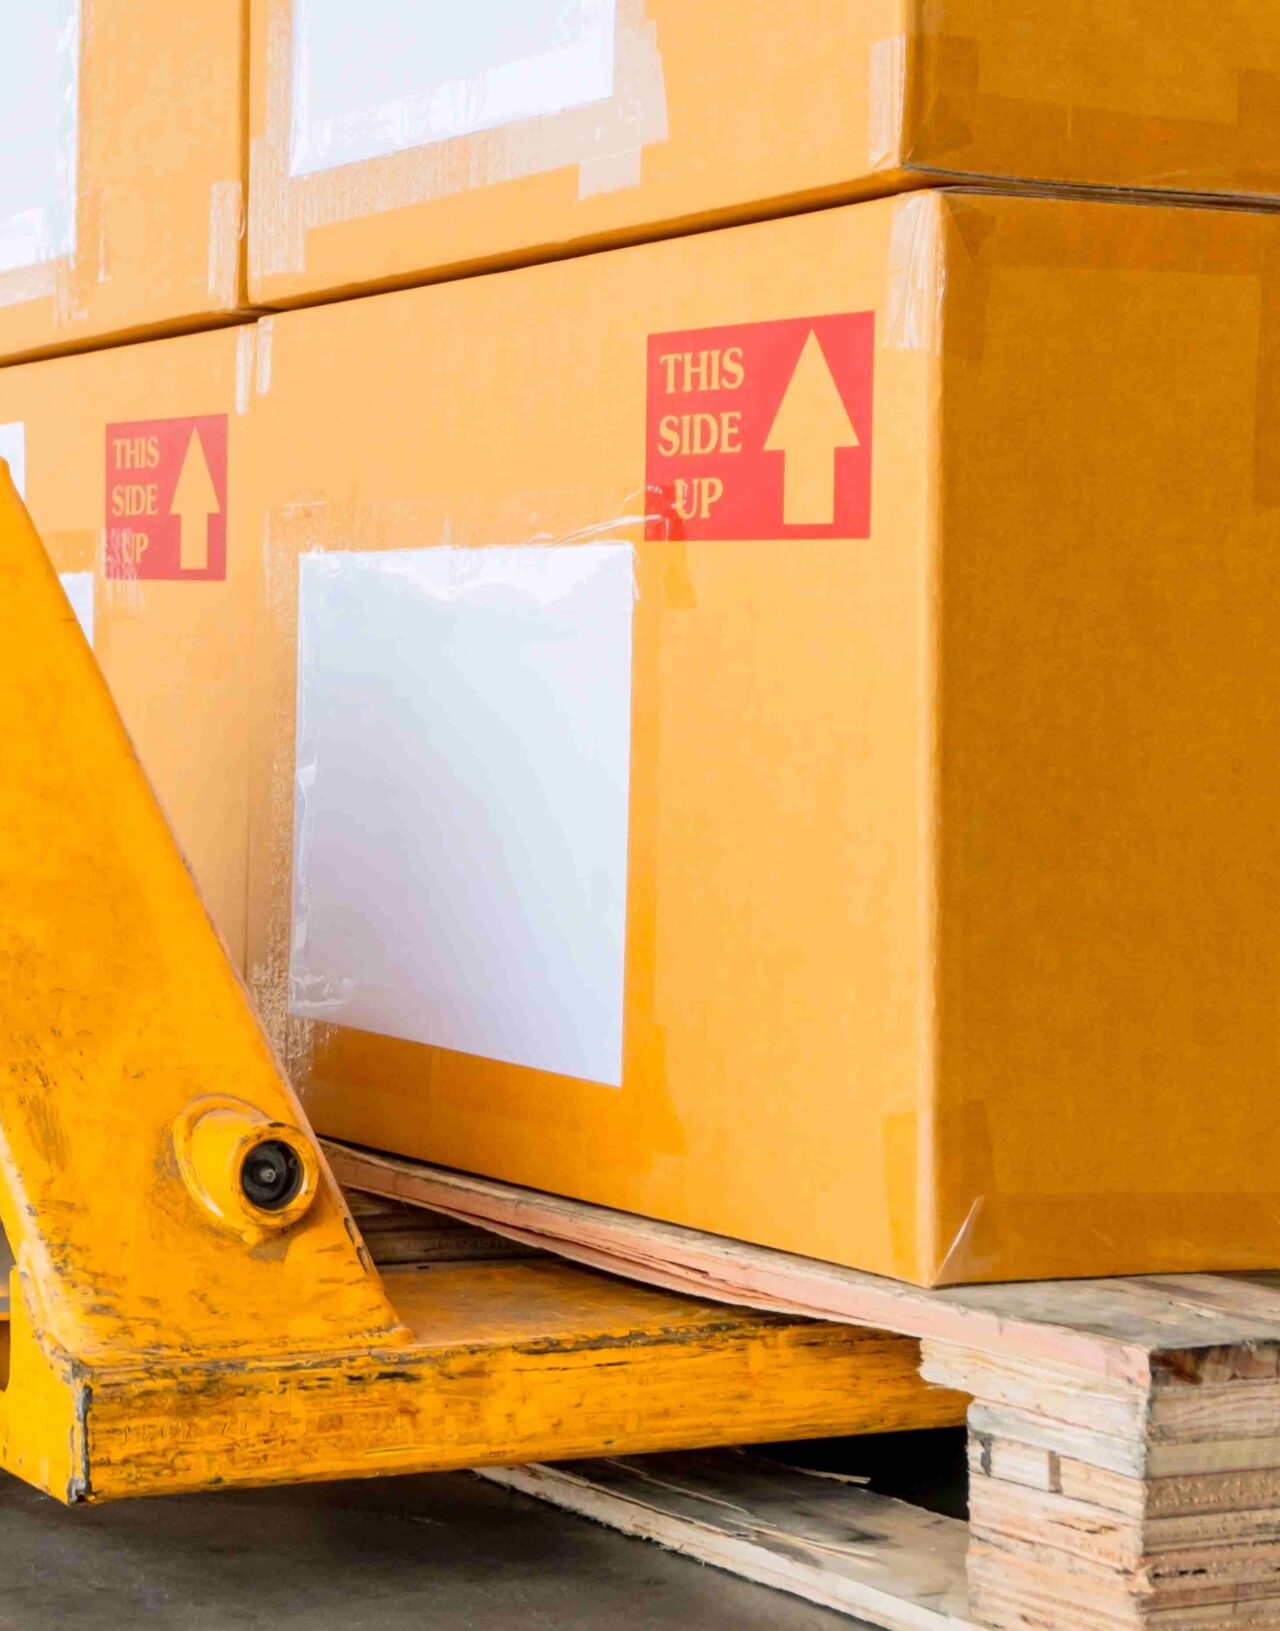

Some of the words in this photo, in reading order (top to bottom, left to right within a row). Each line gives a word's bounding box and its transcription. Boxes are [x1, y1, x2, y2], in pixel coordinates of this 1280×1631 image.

[659, 347, 745, 394] THIS
[658, 411, 742, 457] SIDE
[113, 437, 159, 470] THIS
[112, 484, 158, 517] SIDE
[674, 477, 723, 519] UP
[121, 532, 149, 564] UP
